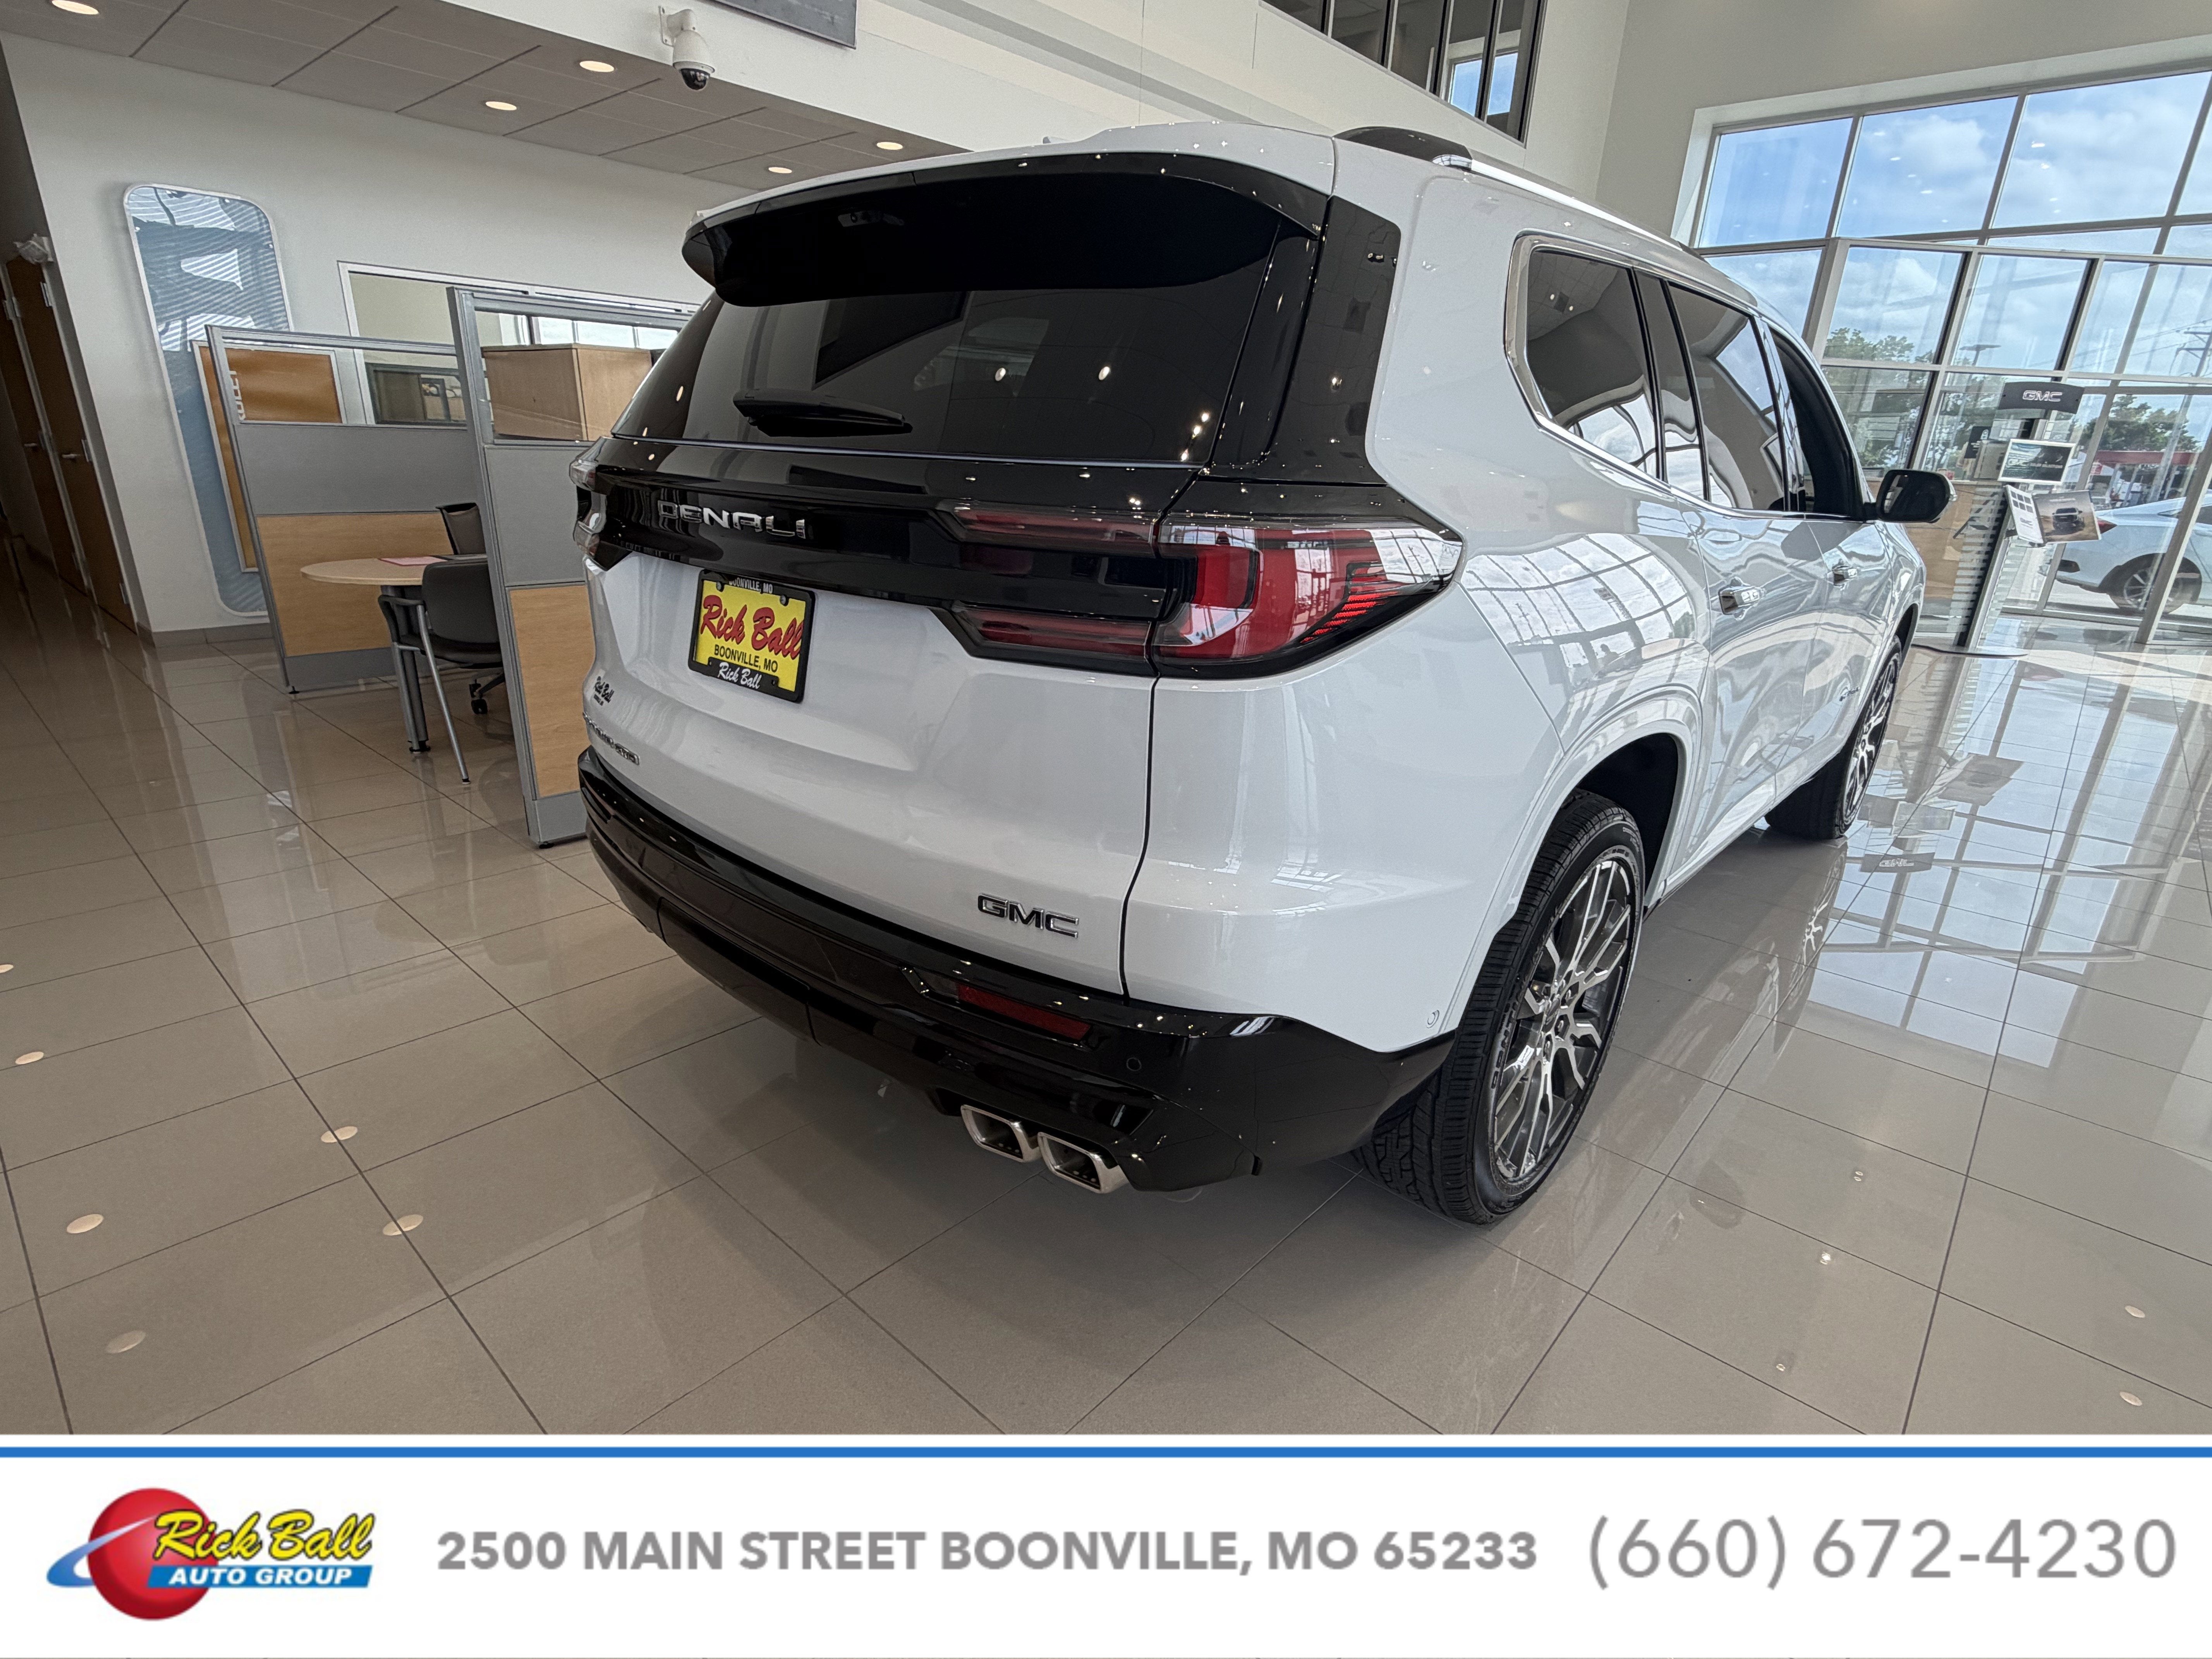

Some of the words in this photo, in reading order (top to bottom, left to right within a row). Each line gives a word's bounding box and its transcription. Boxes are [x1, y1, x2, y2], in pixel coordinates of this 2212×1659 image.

[2022, 390, 2063, 402] GMC
[658, 500, 806, 539] DENALI
[763, 582, 773, 594] MO
[700, 594, 748, 645] Rick
[751, 606, 804, 660] Ball
[714, 644, 761, 671] BOONVILLE,
[763, 658, 778, 673] MO
[717, 662, 739, 685] Rick
[740, 668, 763, 689] Ball
[977, 892, 1079, 939] GMC
